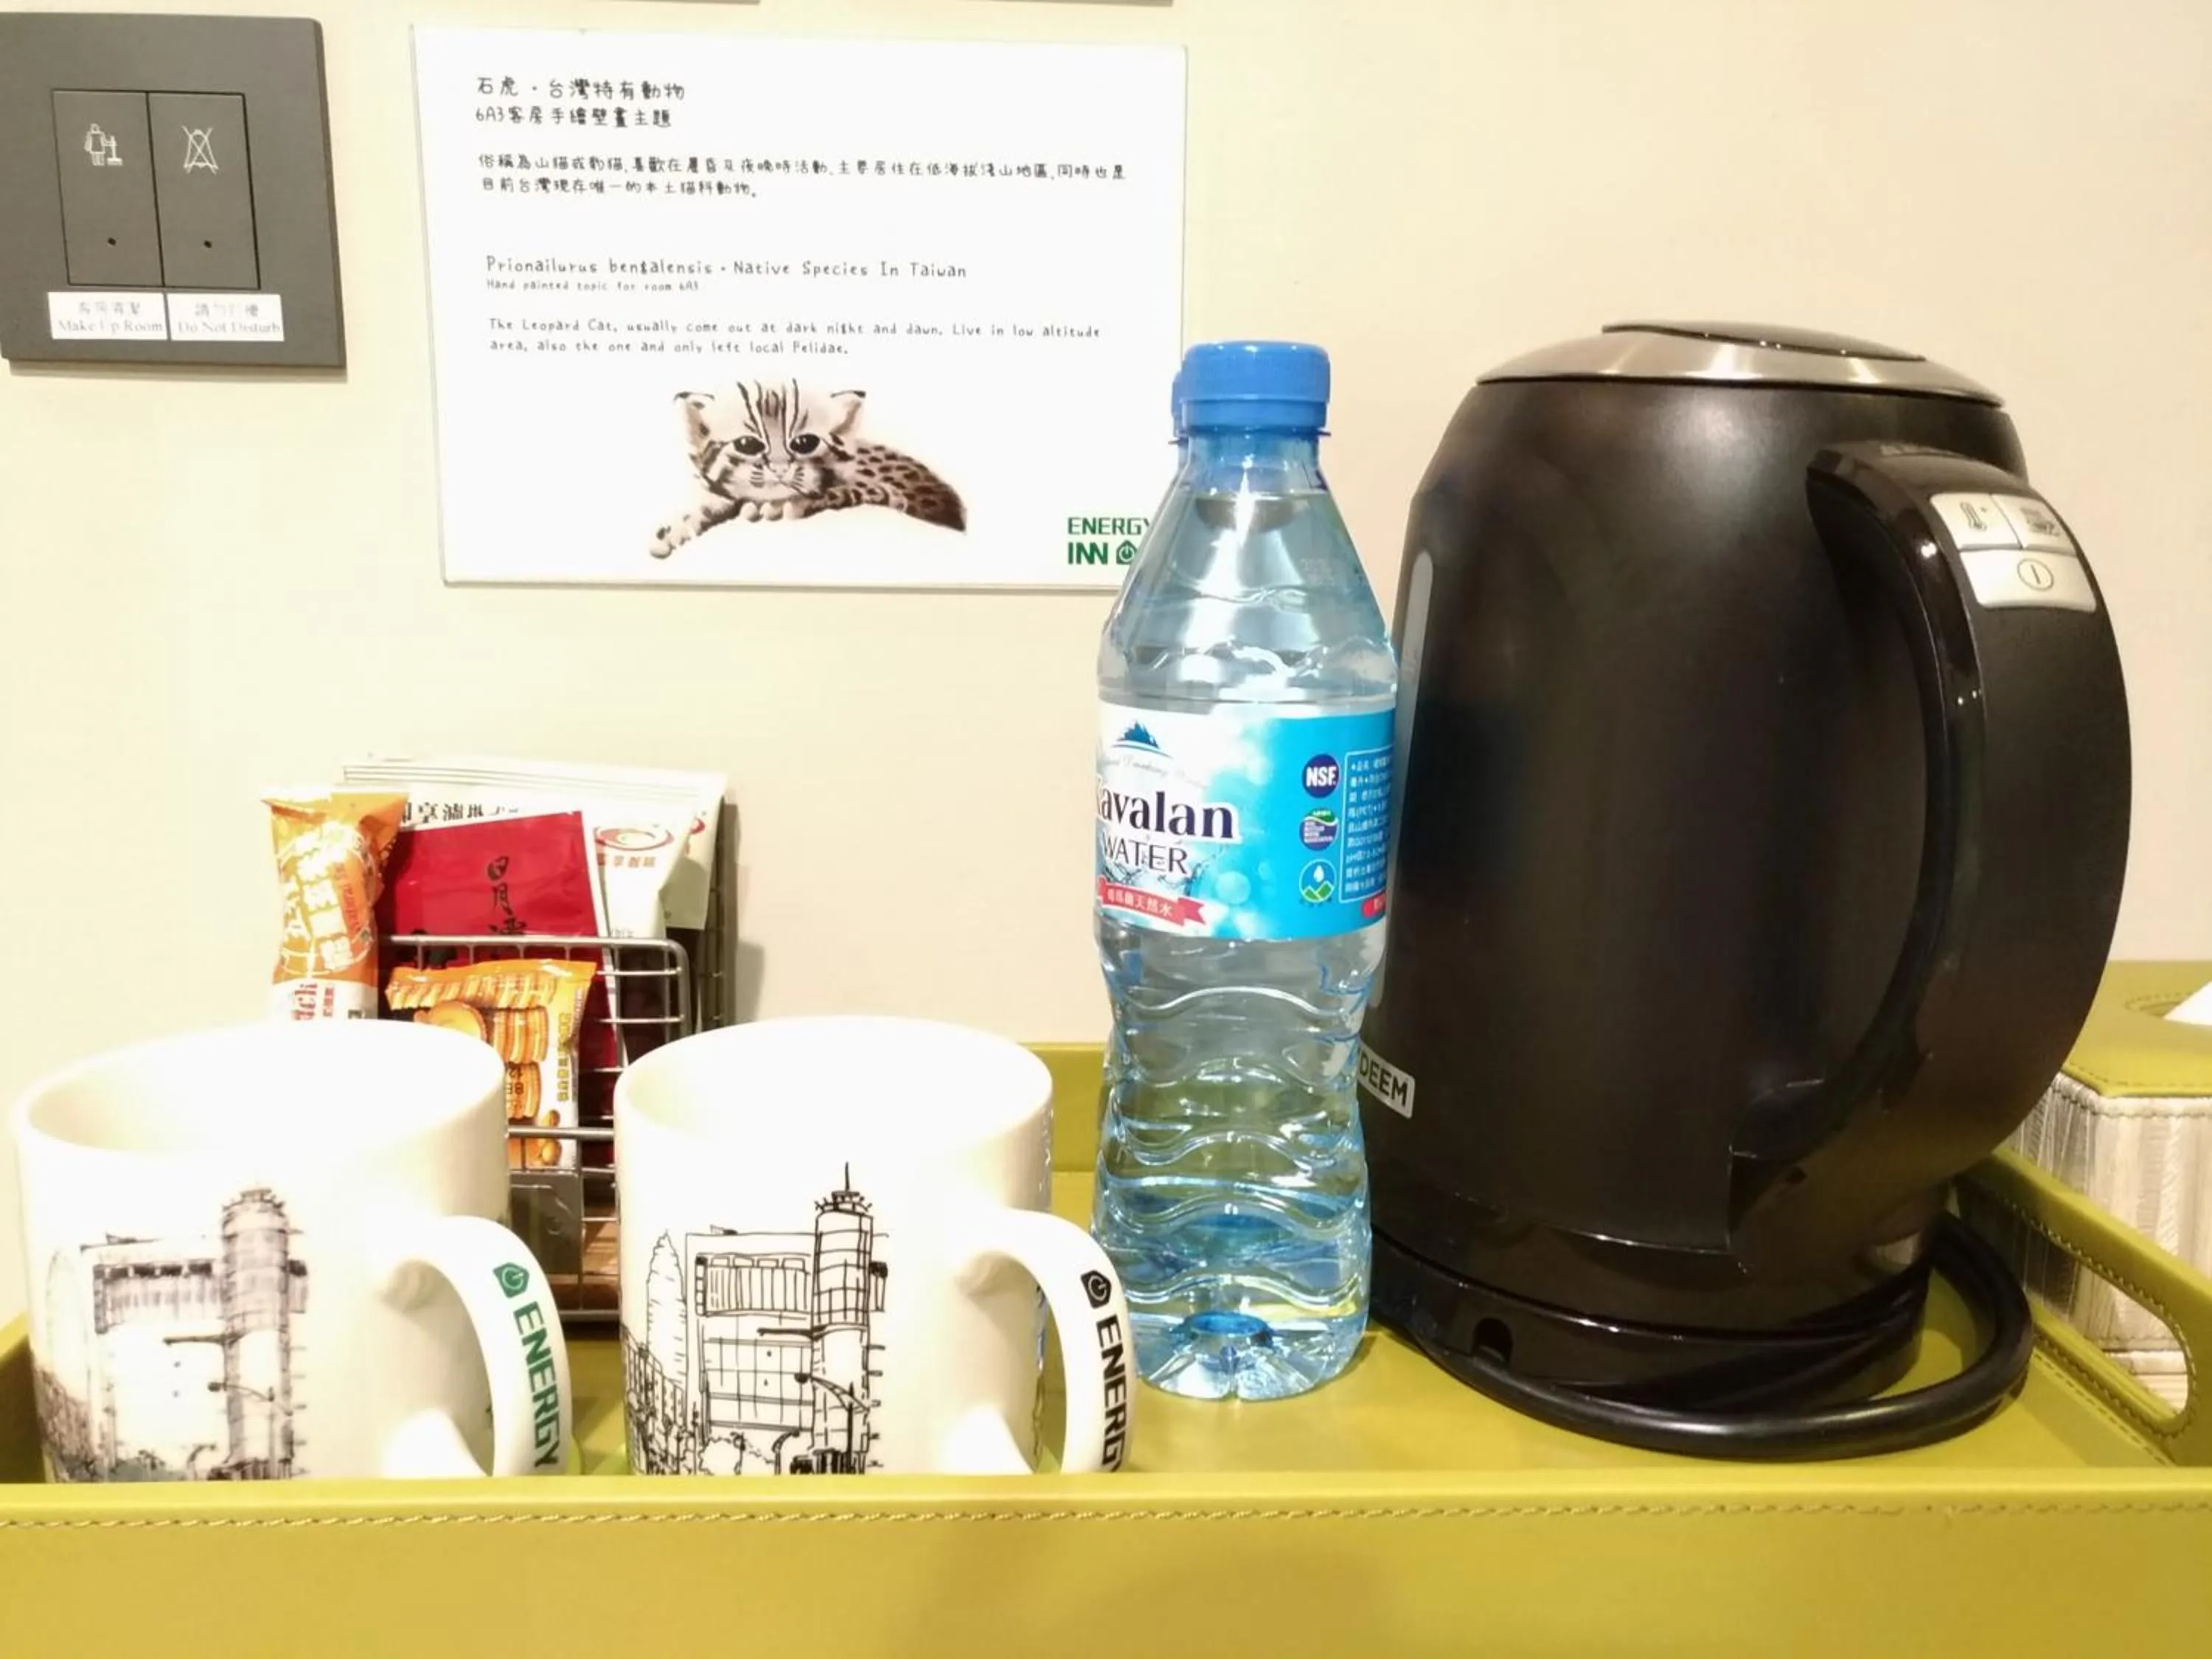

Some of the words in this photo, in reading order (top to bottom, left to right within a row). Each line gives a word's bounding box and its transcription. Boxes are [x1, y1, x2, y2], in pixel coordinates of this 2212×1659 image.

[475, 105, 672, 128] 6A3客房手繪壁畫主題
[486, 254, 598, 274] Prionailurus
[608, 257, 713, 276] bengalensis
[733, 260, 790, 275] Native
[801, 260, 868, 278] Species
[880, 260, 899, 277] In
[909, 262, 967, 278] Taiwan
[487, 279, 515, 290] Hand
[523, 280, 569, 291] painted
[577, 282, 607, 291] topic
[617, 281, 636, 291] for
[644, 283, 672, 291] room
[124, 319, 163, 332] Room
[489, 318, 512, 330] The
[522, 319, 580, 332] Leopard
[627, 319, 678, 333] usually
[686, 323, 717, 333] come
[728, 324, 751, 333] out
[760, 322, 776, 333] at
[785, 322, 817, 333] dark
[873, 322, 897, 335] and
[952, 324, 981, 336] Live
[991, 324, 1004, 336] in
[1012, 324, 1034, 337] low
[1042, 324, 1099, 338] altitude
[537, 339, 567, 352] also
[575, 341, 598, 352] the
[608, 343, 631, 352] one
[640, 341, 664, 352] and
[674, 341, 702, 354] only
[750, 341, 784, 354] local
[1068, 542, 1108, 565] INN
[1305, 766, 1336, 787] NSF
[1103, 832, 1188, 874] WATER
[513, 1301, 560, 1467] ENERGY
